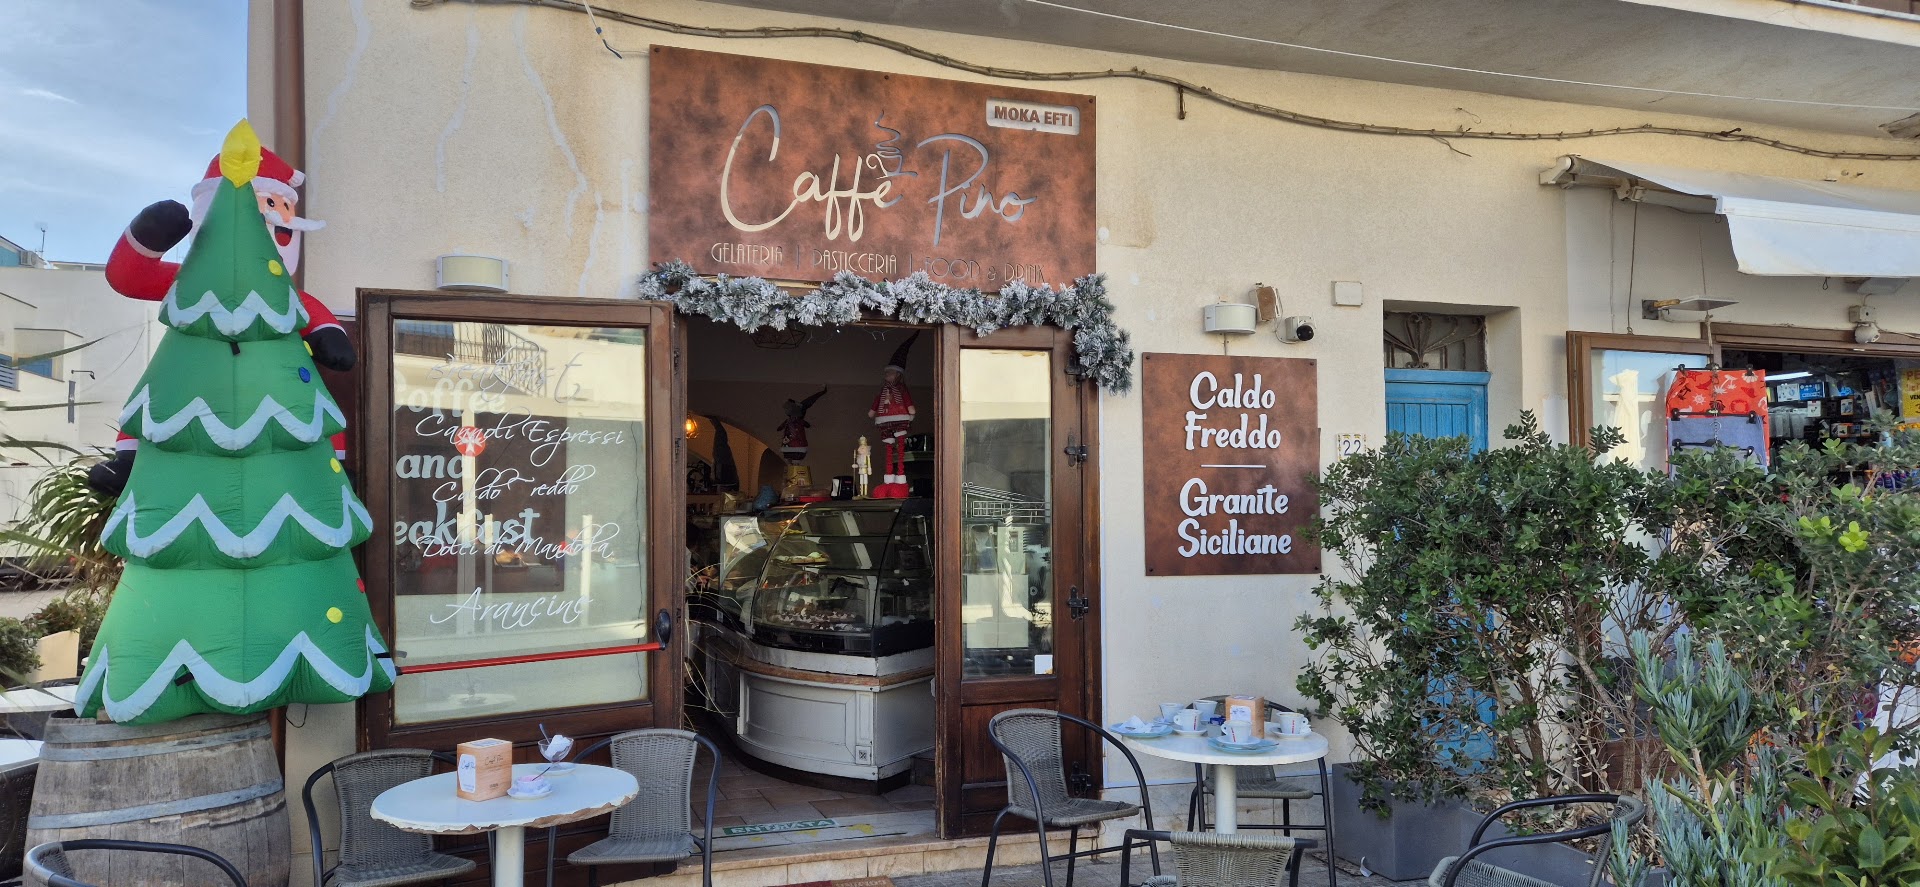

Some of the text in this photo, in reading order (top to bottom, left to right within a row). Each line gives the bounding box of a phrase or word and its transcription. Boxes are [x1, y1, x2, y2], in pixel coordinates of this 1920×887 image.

[994, 105, 1073, 127] MOKA EFTI
[917, 133, 1037, 246] Pino
[711, 242, 1045, 283] GELATERIA PASTICCERIA FOOD & DRINK
[1190, 371, 1276, 410] Caldo
[415, 406, 624, 468] Cannoli Espressi
[1185, 411, 1281, 450] Freddo
[1343, 440, 1362, 456] 22
[1179, 477, 1288, 517] Granite
[416, 523, 482, 558] Dolci
[1177, 518, 1292, 558] Siciliane
[732, 819, 834, 835] ENTRATA
